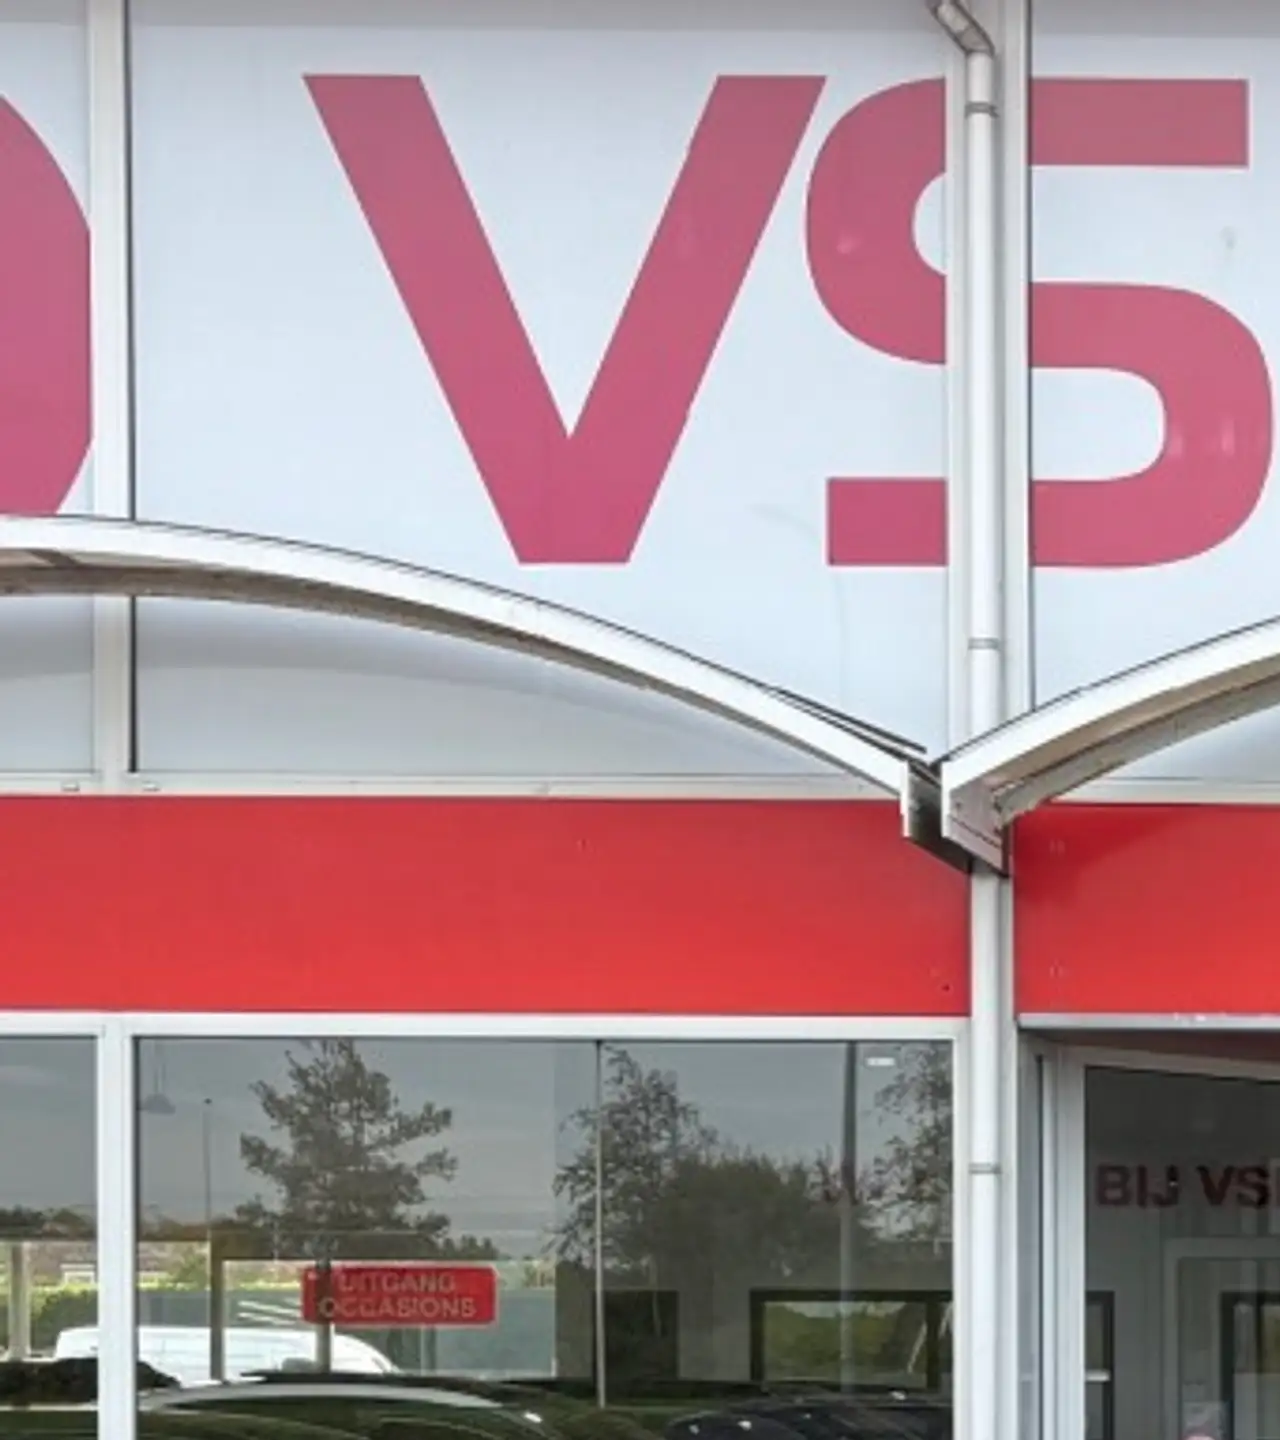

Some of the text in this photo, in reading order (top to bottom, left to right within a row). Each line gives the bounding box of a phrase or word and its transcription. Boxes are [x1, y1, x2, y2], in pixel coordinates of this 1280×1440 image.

[1097, 1165, 1178, 1210] BIJ
[340, 1272, 455, 1293] UITGANG
[319, 1297, 478, 1318] OCCASIONS
